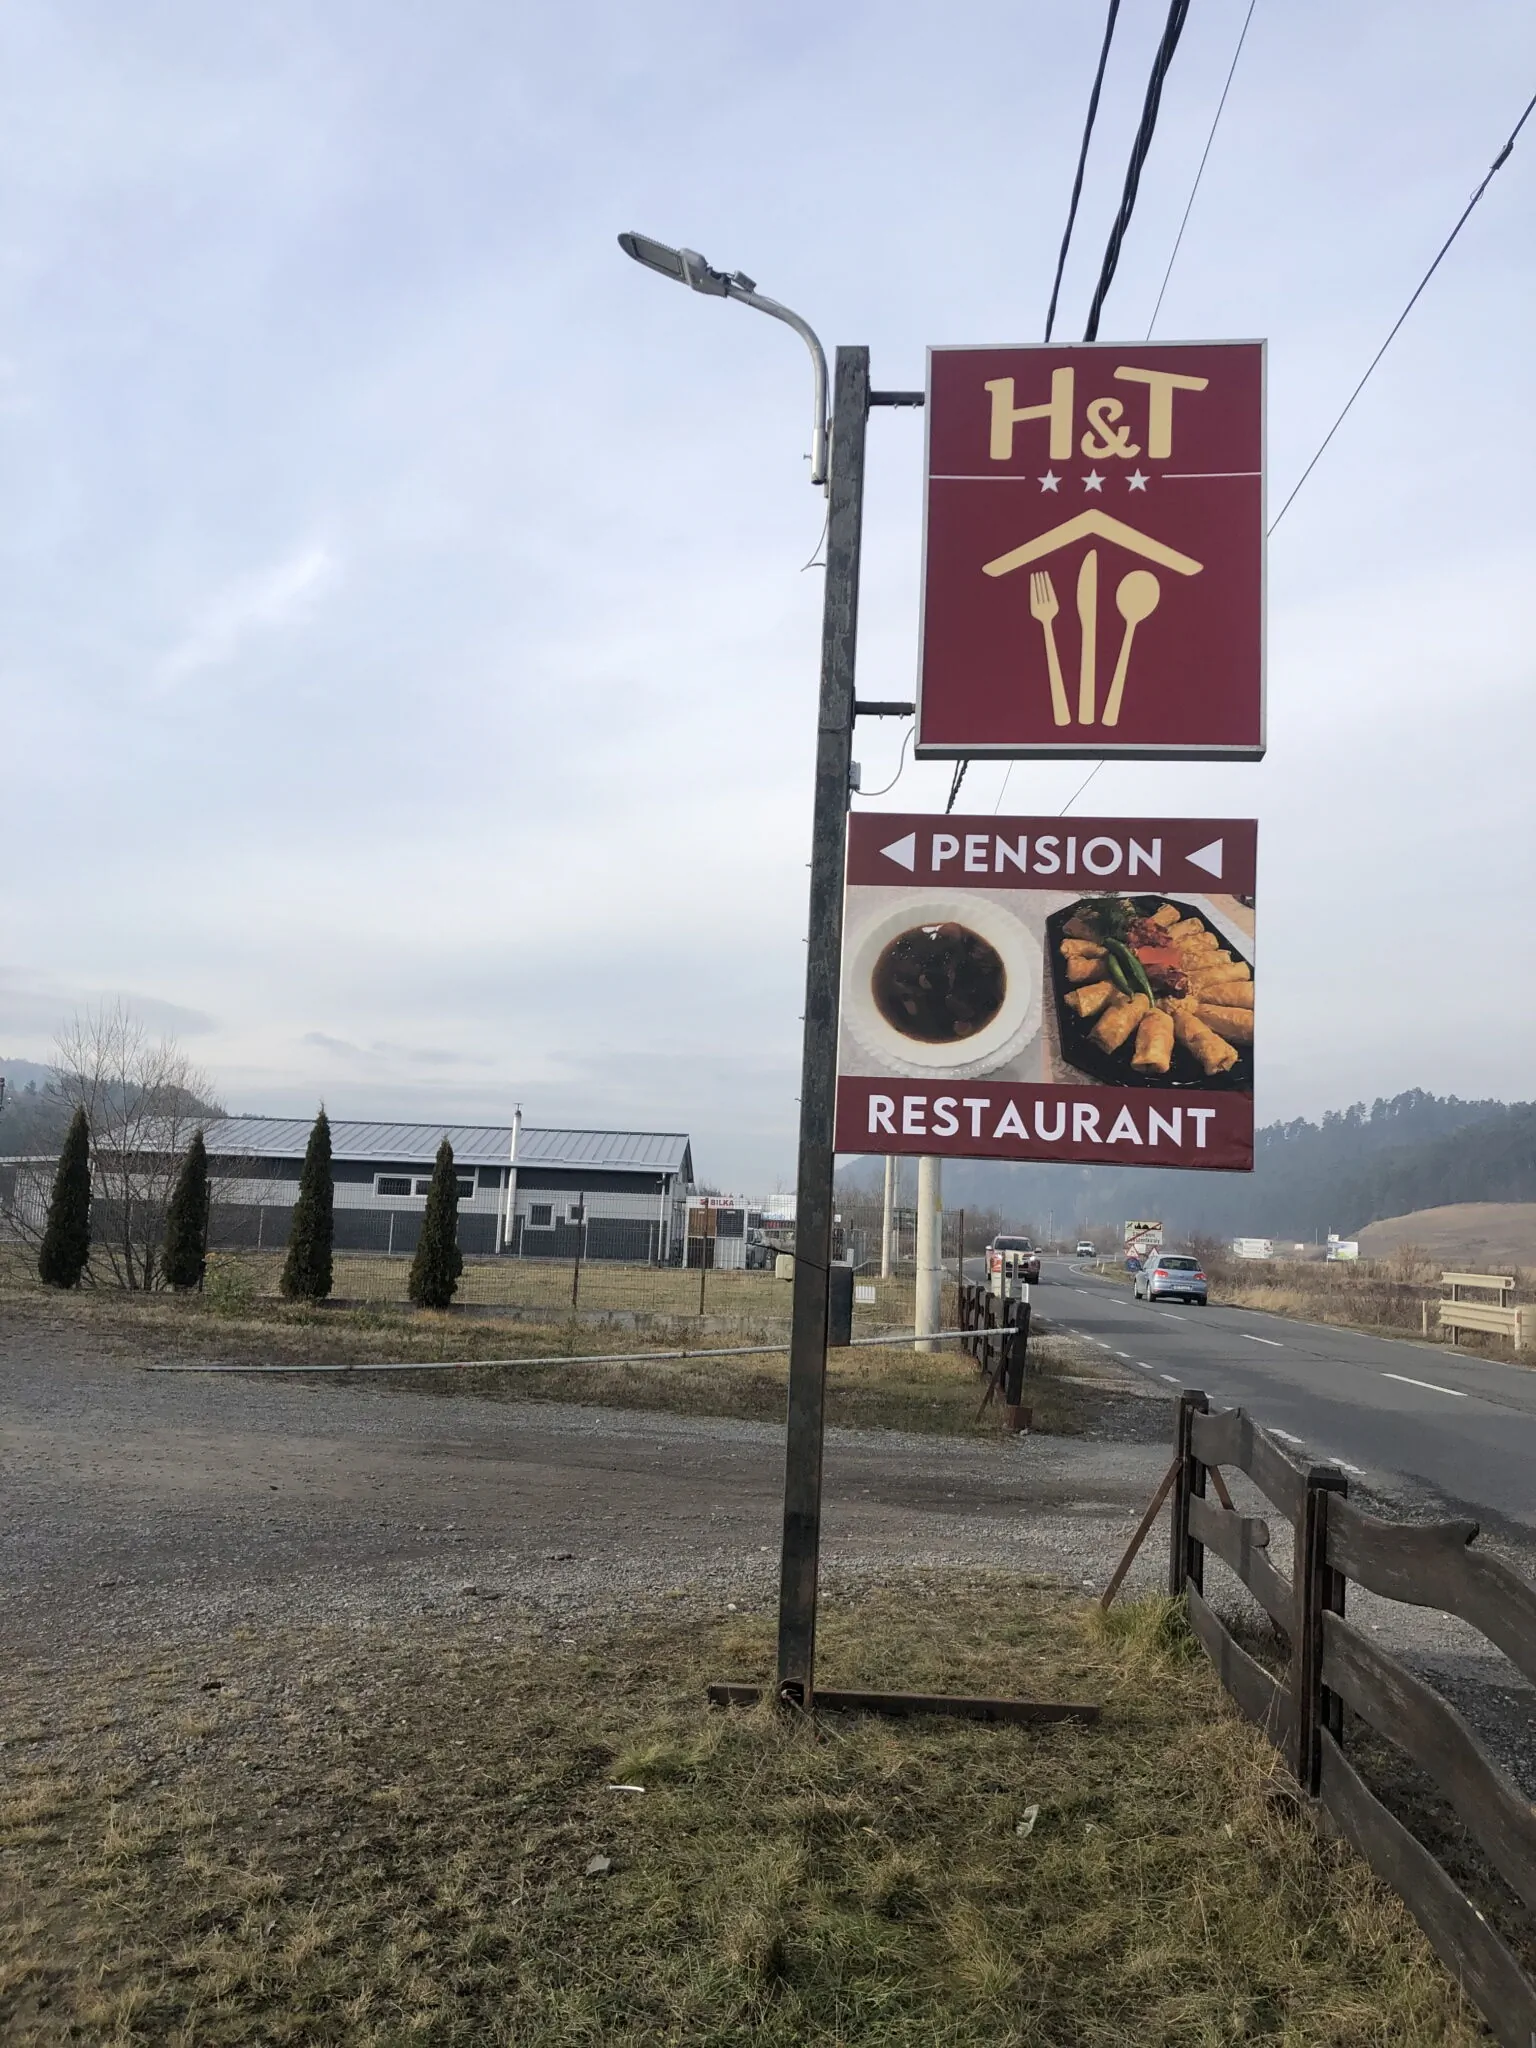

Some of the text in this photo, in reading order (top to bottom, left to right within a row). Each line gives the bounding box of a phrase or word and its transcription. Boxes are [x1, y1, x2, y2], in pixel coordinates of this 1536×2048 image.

[984, 366, 1209, 460] H&T
[931, 833, 1162, 877] PENSION
[868, 1094, 1216, 1148] RESTAURANT
